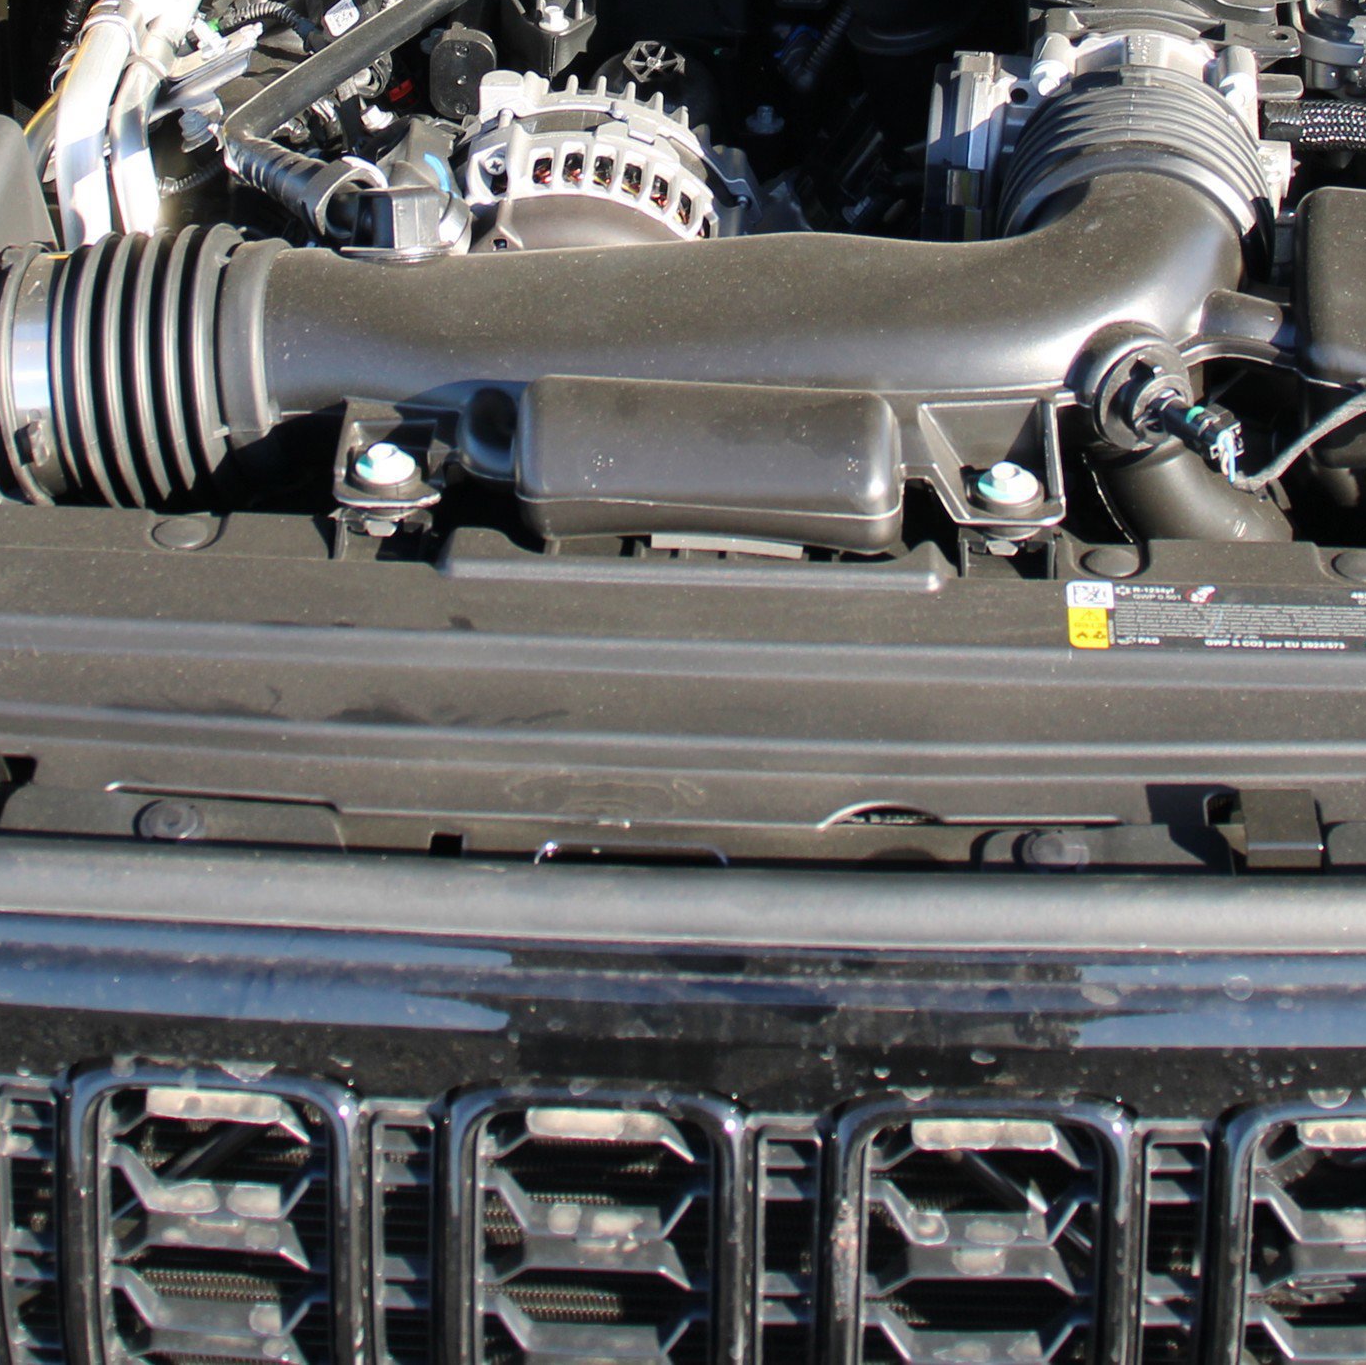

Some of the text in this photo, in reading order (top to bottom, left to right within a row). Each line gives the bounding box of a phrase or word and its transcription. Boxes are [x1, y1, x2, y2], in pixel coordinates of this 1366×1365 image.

[1137, 636, 1161, 645] PAG
[1204, 639, 1231, 647] GWP
[1232, 639, 1241, 647] &
[1241, 639, 1265, 648] CO2
[1265, 640, 1283, 649] per
[1284, 640, 1300, 649] EU
